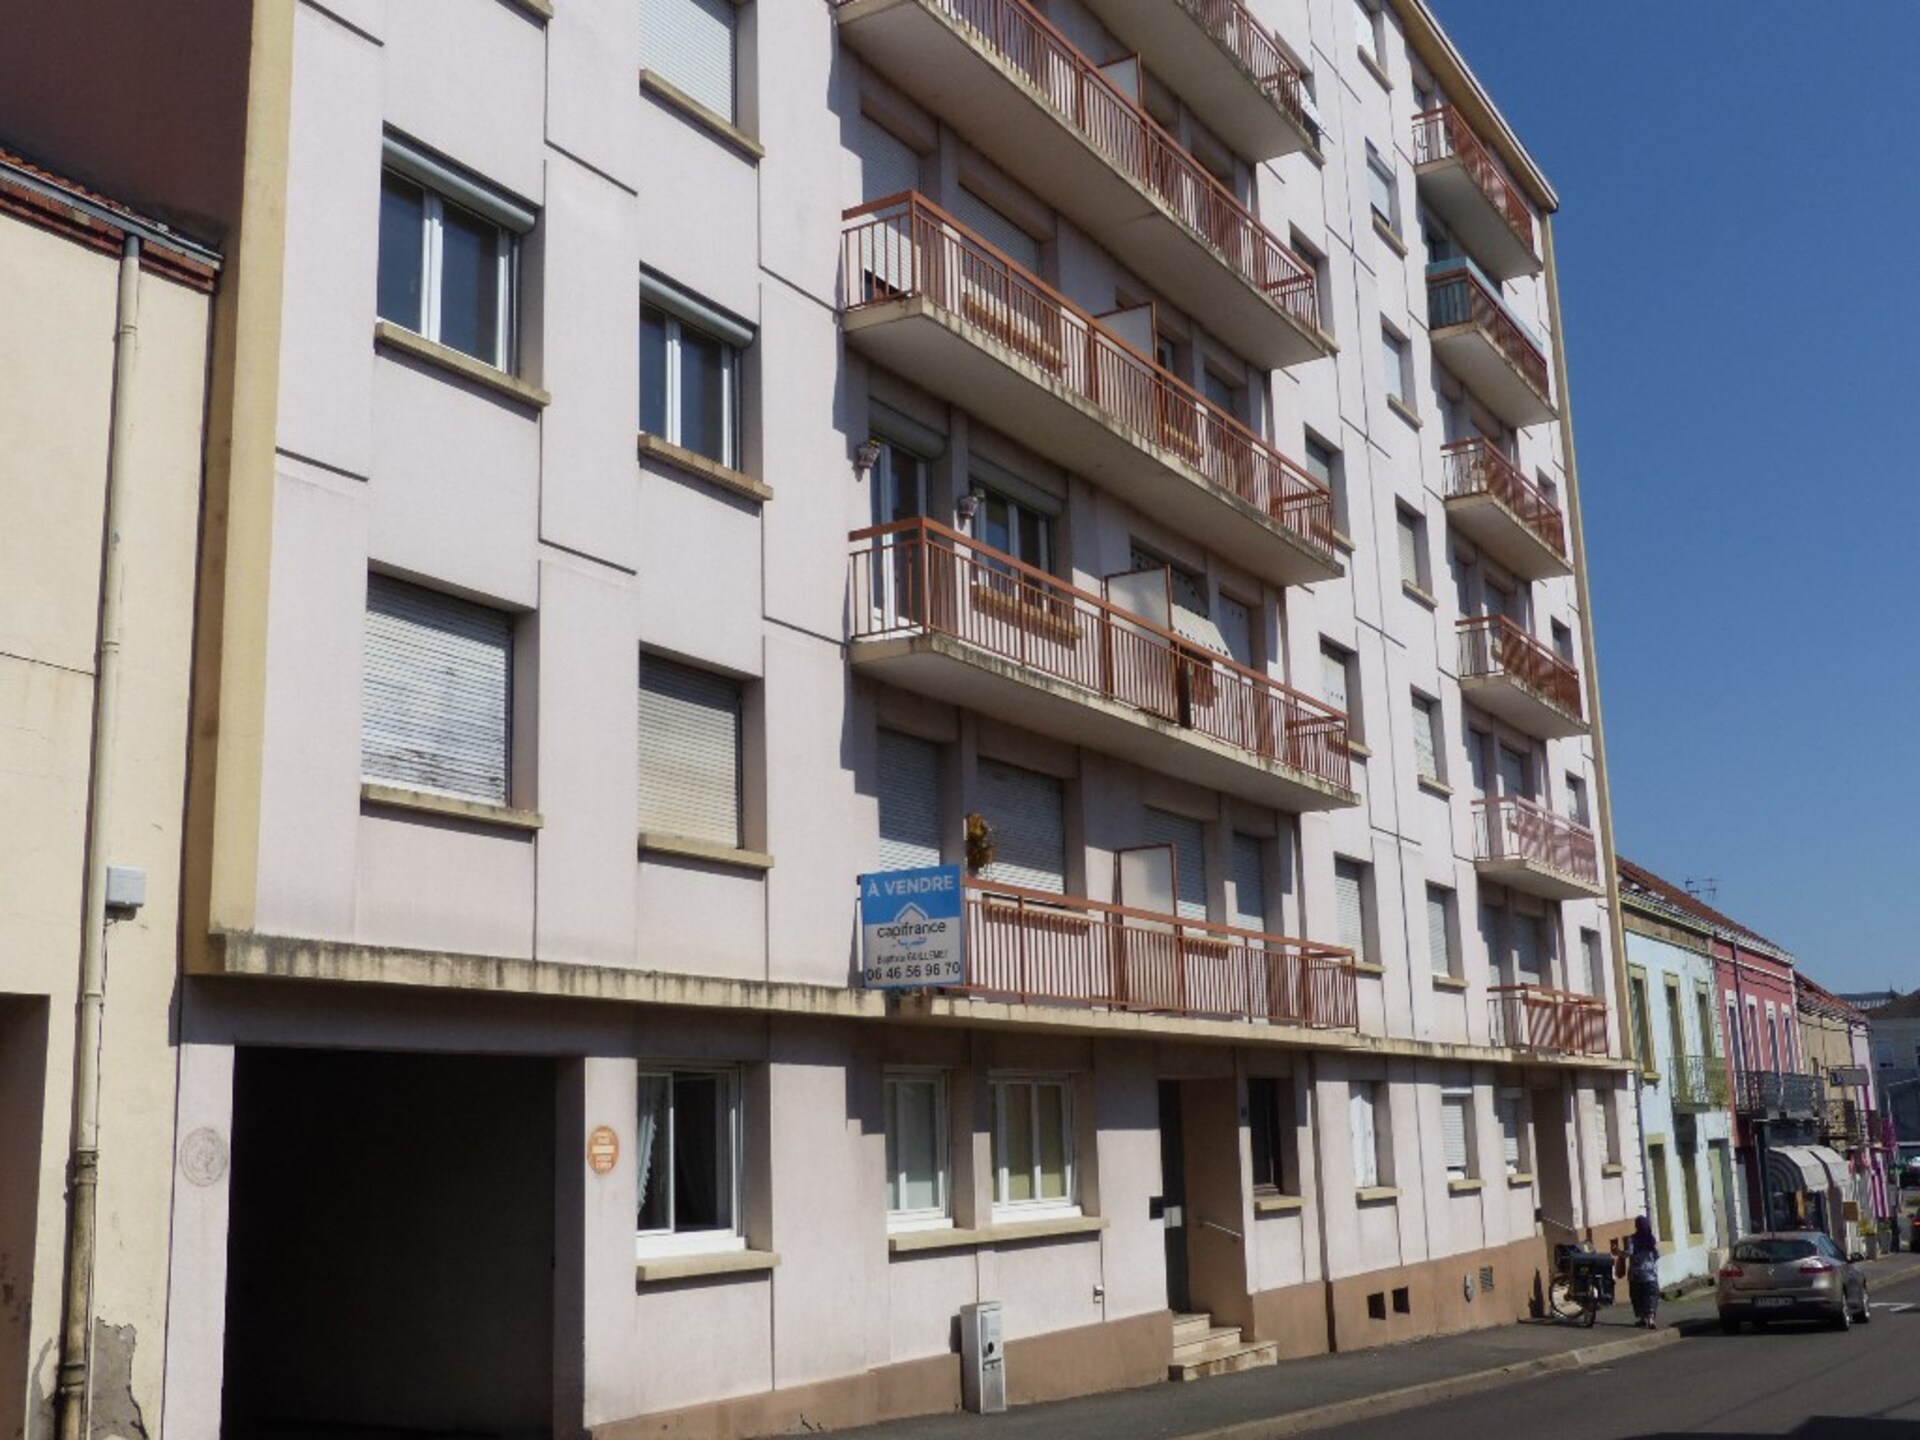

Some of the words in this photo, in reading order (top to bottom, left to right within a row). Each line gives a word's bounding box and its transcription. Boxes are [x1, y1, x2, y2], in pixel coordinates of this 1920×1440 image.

[884, 875, 955, 896] VENDRE
[877, 921, 946, 939] capifrance
[866, 967, 882, 981] 06
[945, 961, 961, 975] 70
